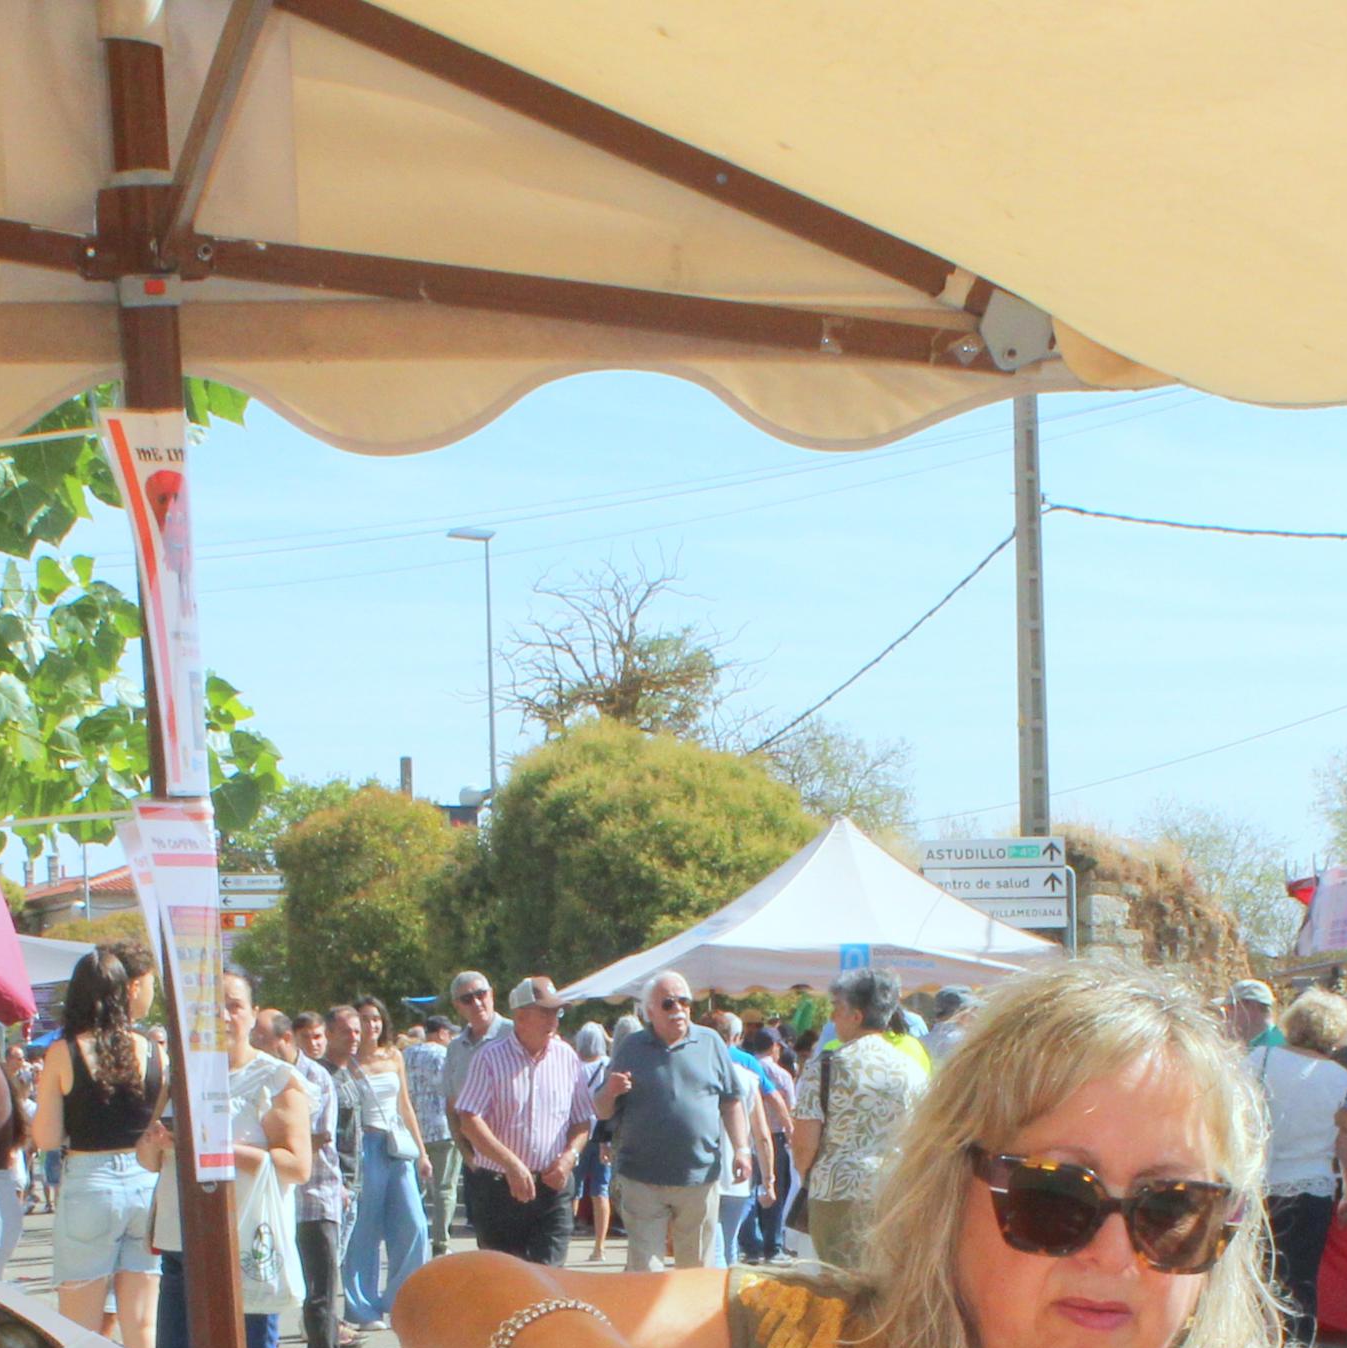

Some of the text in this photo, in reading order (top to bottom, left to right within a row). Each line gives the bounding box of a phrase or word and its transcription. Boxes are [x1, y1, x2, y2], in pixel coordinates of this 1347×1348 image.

[926, 848, 1006, 860] ASTUDILLO
[937, 878, 1030, 890] entro de salud
[990, 908, 1063, 919] VILLAMEDIANA
